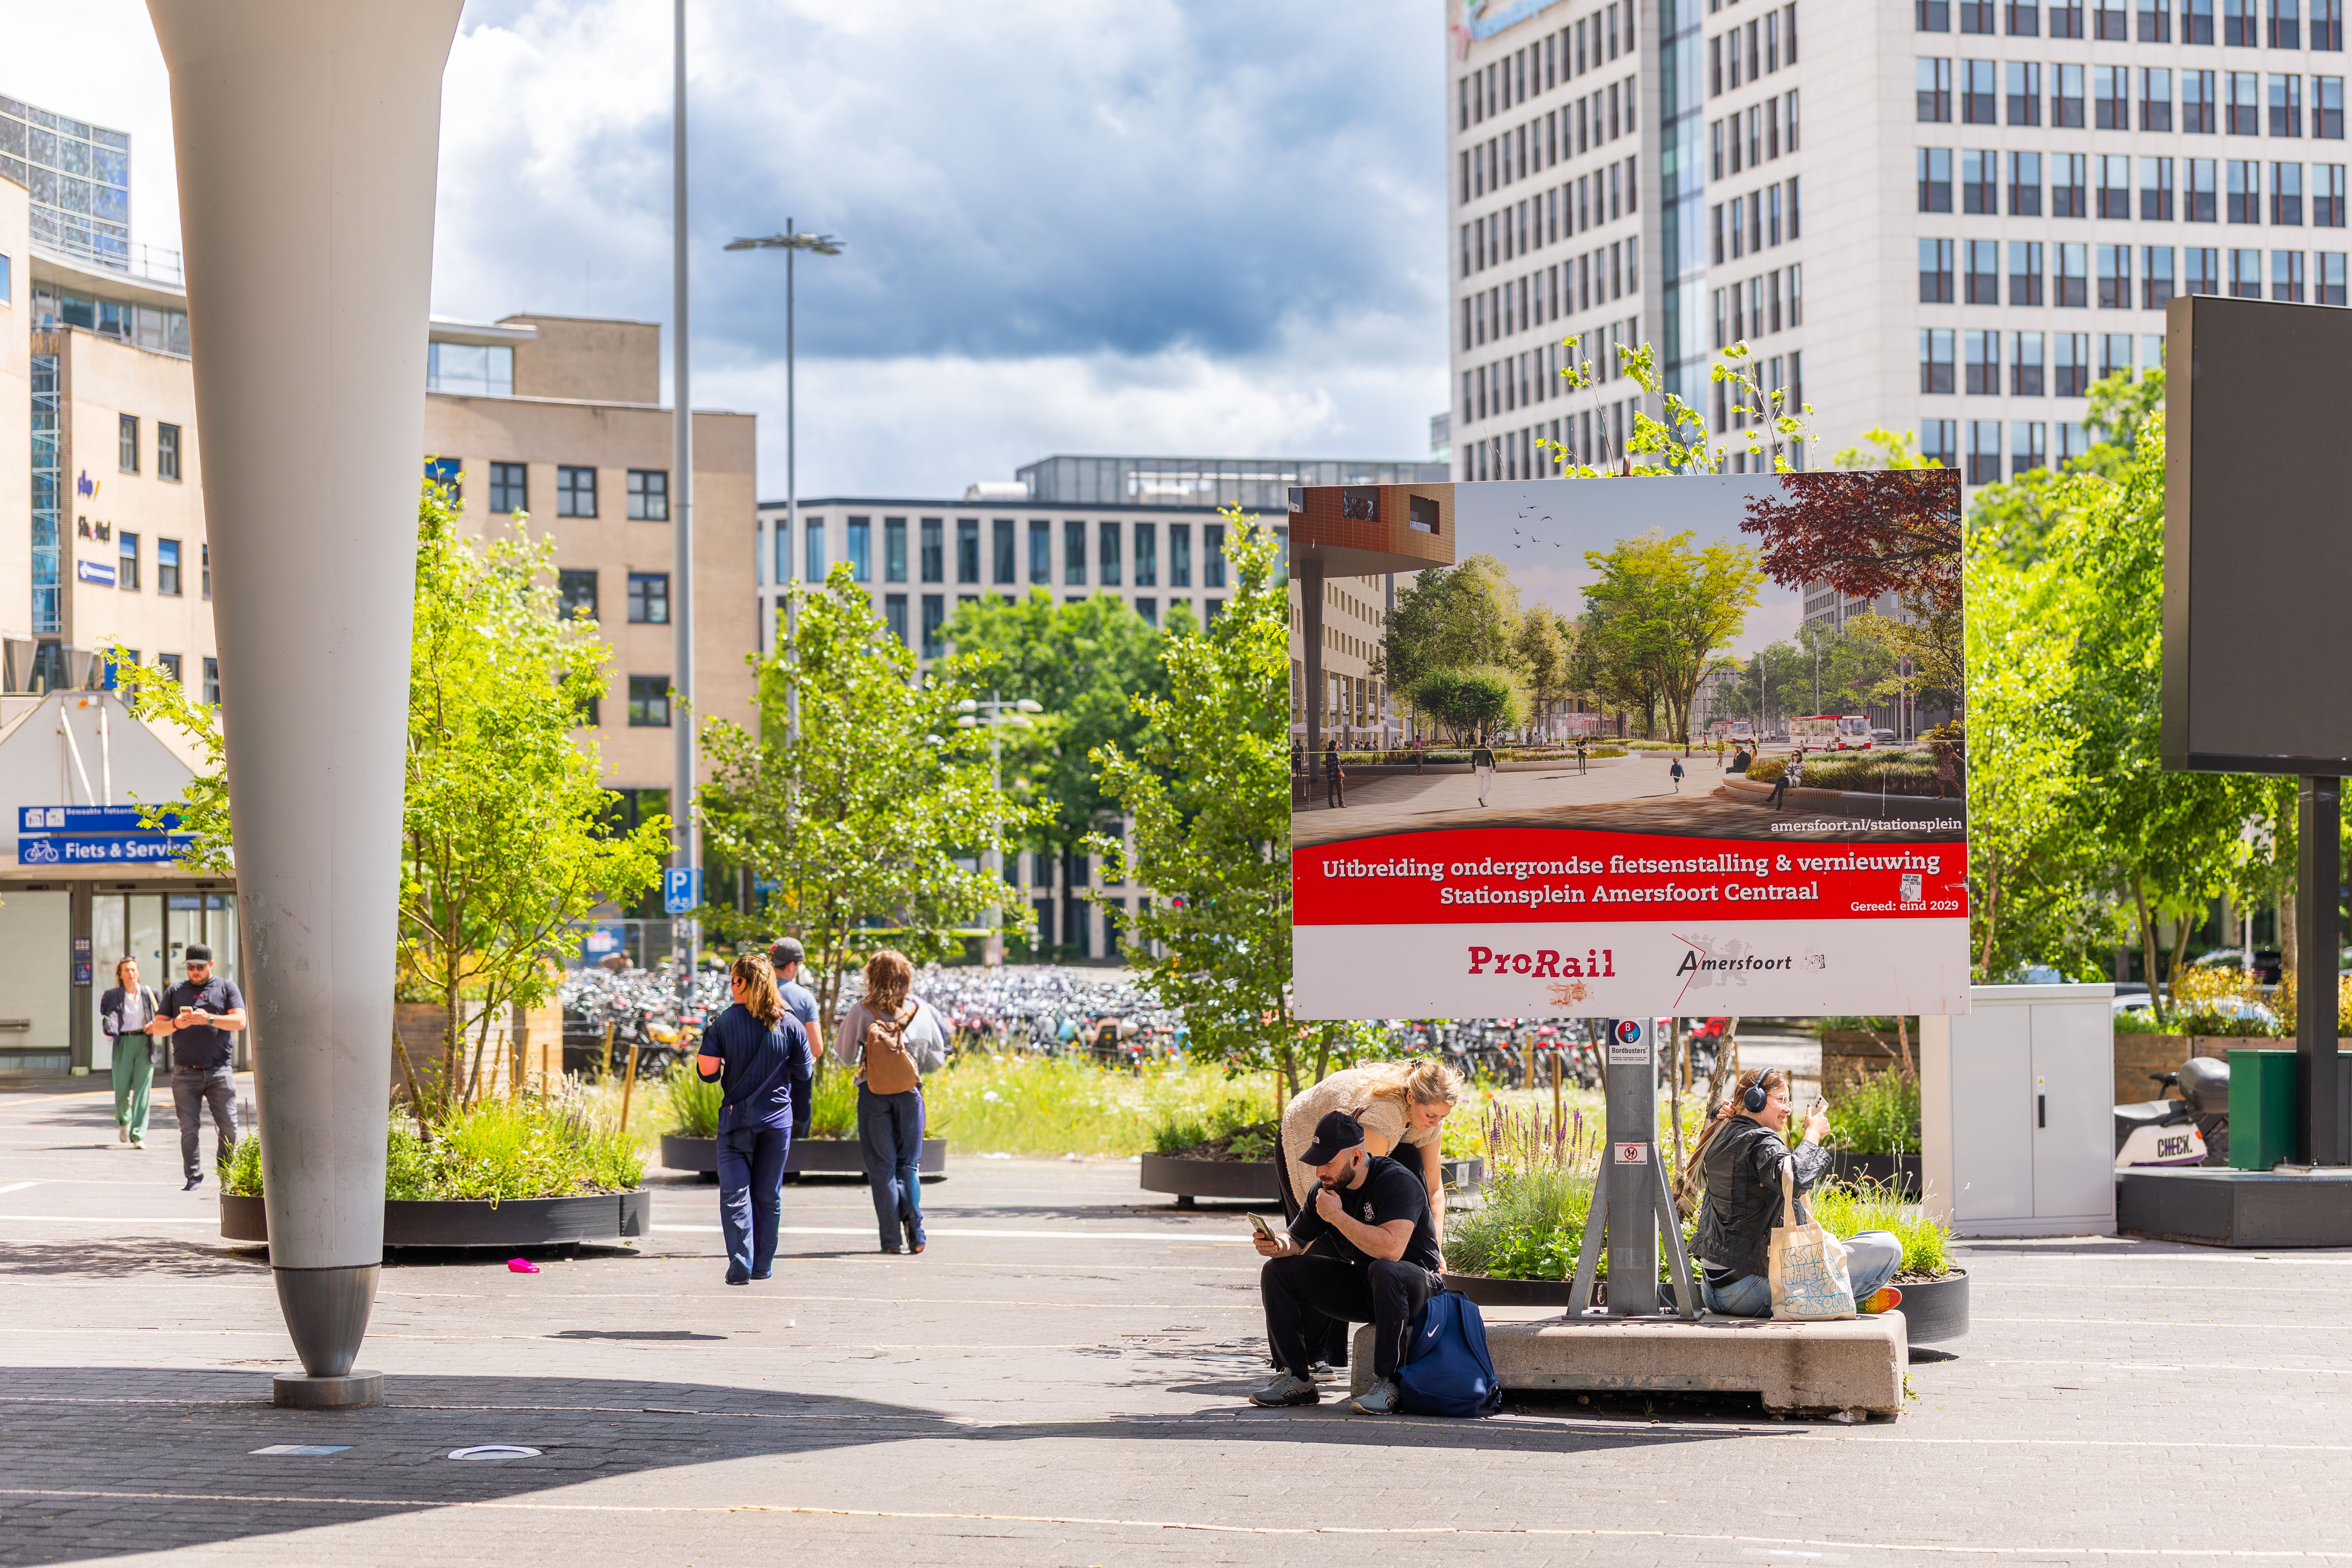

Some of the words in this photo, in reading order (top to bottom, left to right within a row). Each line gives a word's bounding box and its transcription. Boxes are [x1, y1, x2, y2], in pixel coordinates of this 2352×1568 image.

[1771, 817, 1962, 833] amersfoort.nl/stationsplein
[66, 843, 105, 859] Fiets
[110, 842, 122, 858] &
[1323, 858, 1444, 881] Uitbreiding
[1451, 856, 1603, 880] ondergrondse
[1610, 853, 1768, 877] fietsenstalling
[1776, 854, 1791, 871] &
[1797, 852, 1940, 875] vernieuwing
[672, 871, 687, 894] P
[1441, 885, 1585, 908] Stationsplein
[1592, 883, 1718, 902] Amersfoort
[1725, 881, 1818, 900] Centraal
[1851, 901, 1896, 911] Gereed:
[1900, 901, 1926, 911] eind
[1930, 900, 1958, 910] 2029
[1468, 946, 1615, 978] ProRail
[1676, 950, 1792, 976] Amersfoort
[1625, 1023, 1631, 1031] B
[1628, 1033, 1634, 1042] B
